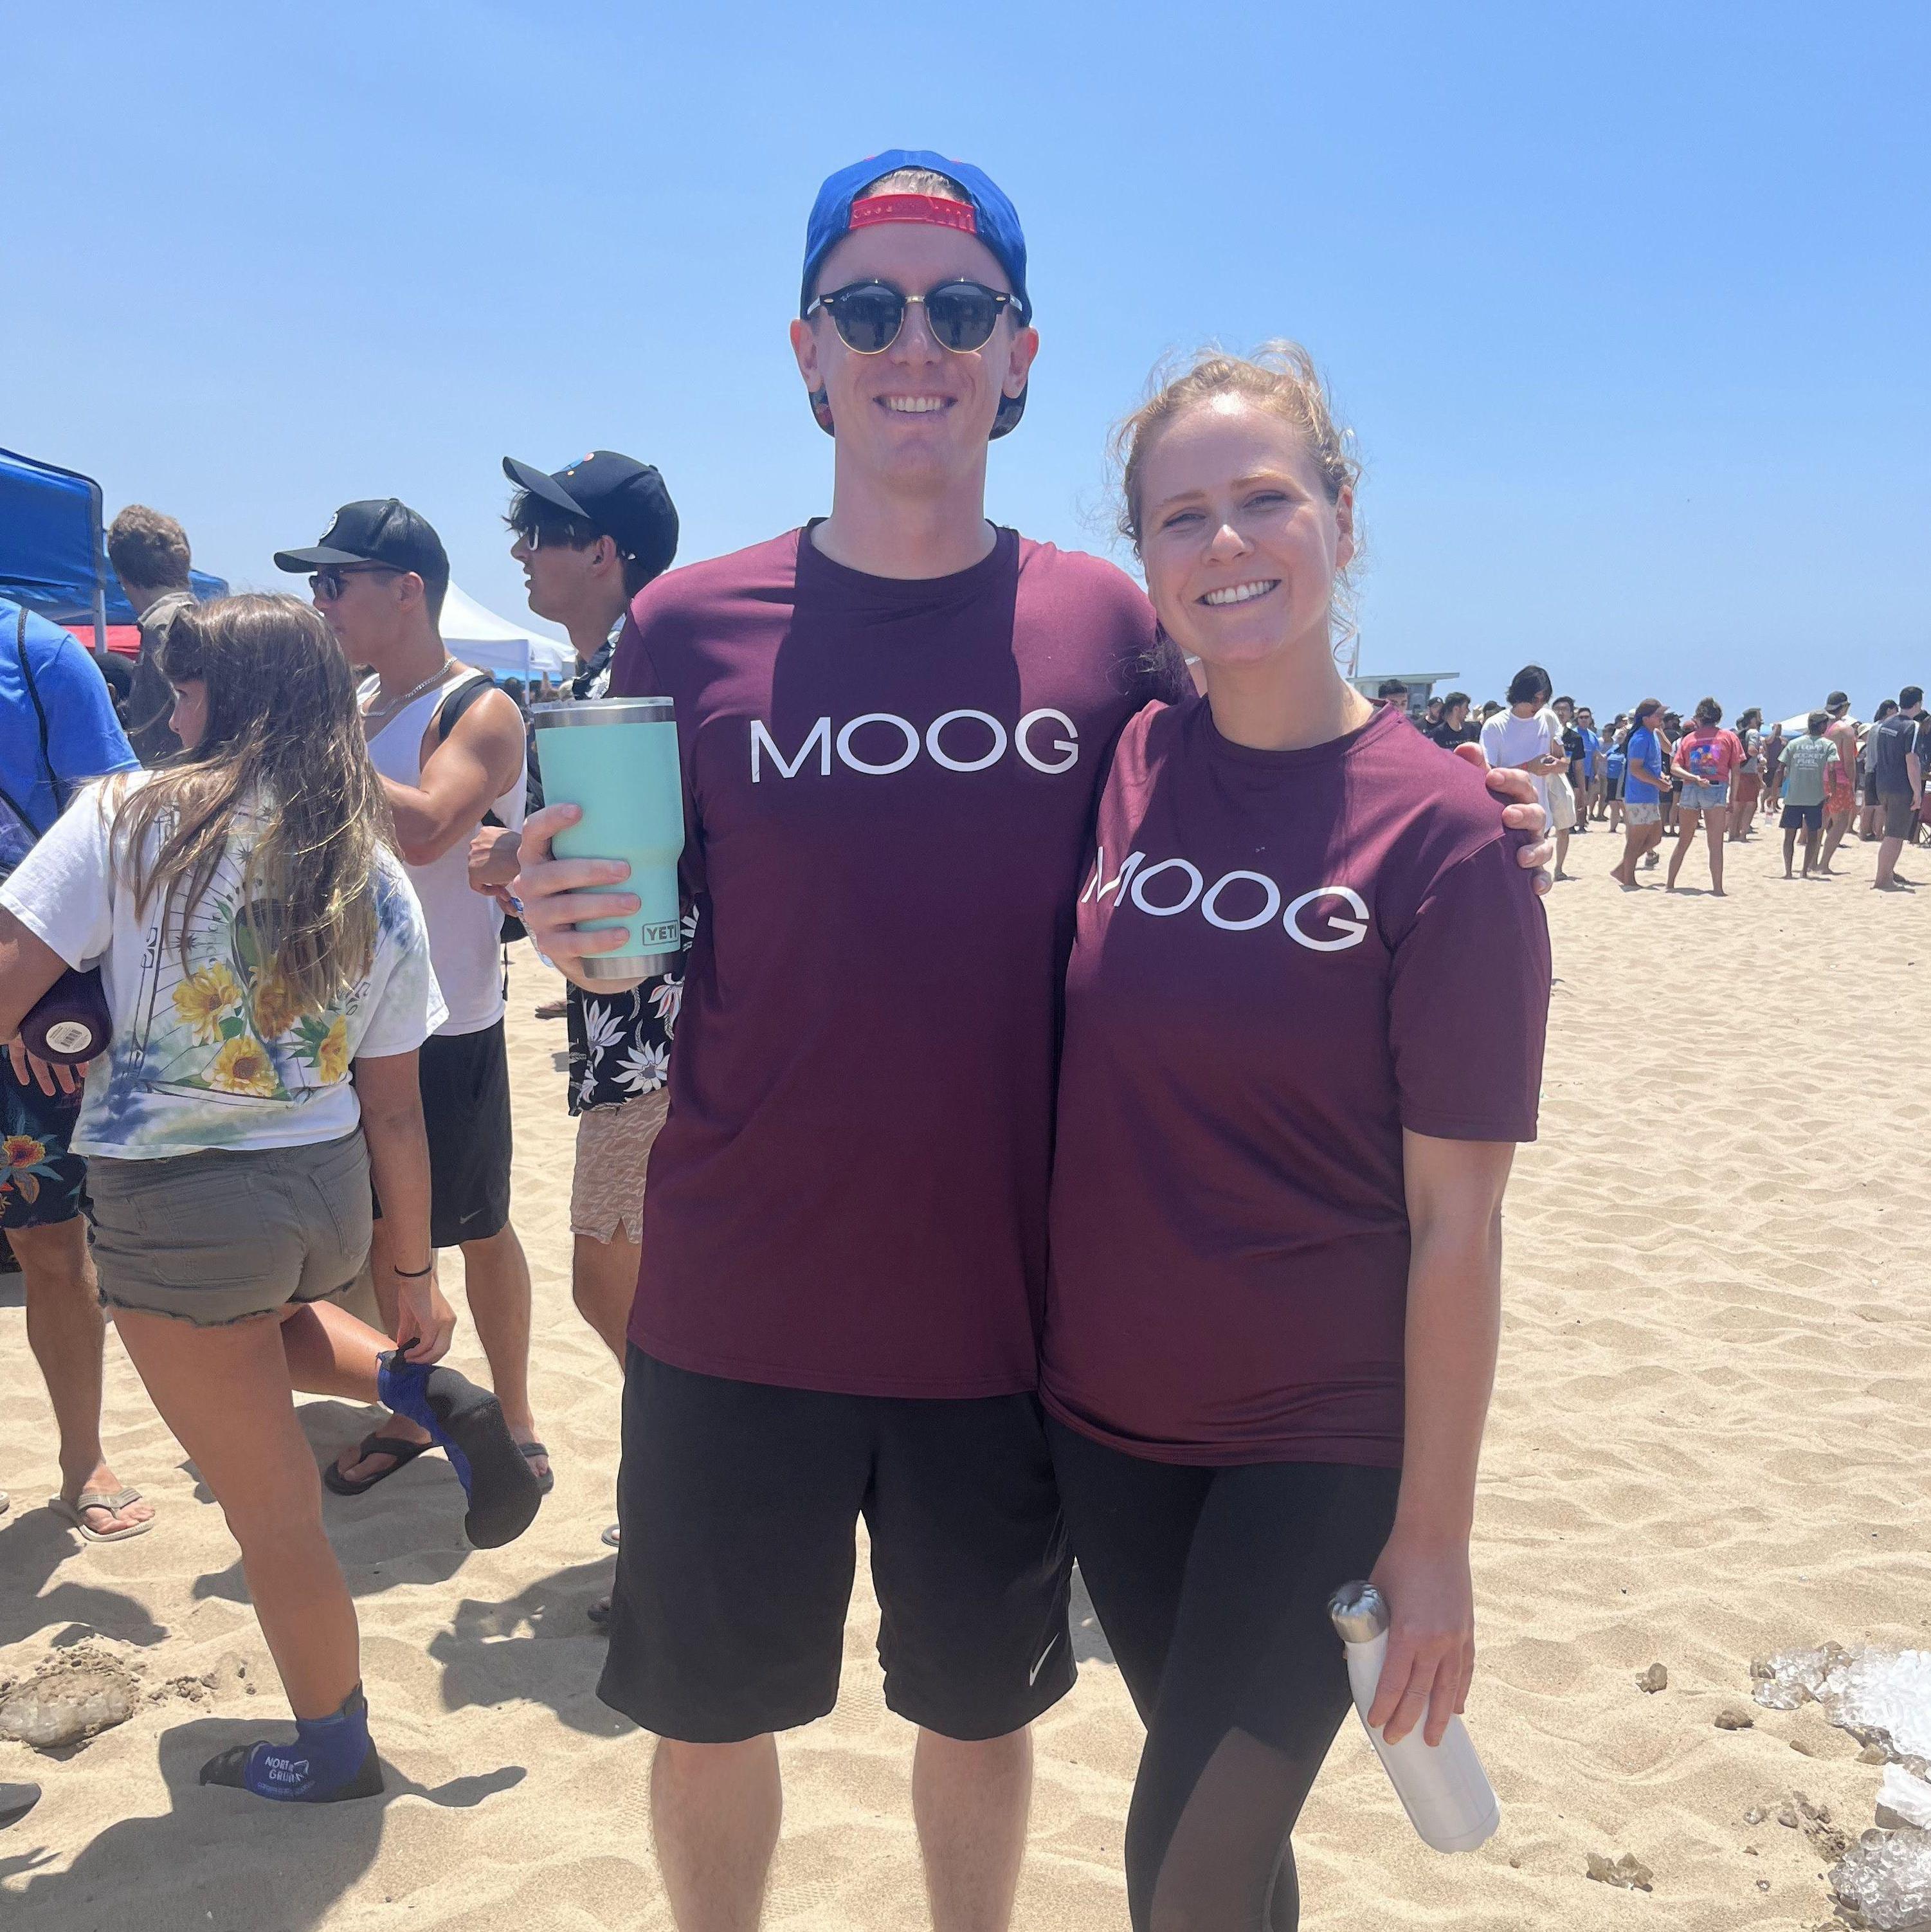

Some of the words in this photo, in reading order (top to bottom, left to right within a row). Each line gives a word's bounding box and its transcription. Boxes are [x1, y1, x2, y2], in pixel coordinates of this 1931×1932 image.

[750, 708, 1078, 783] MOOG
[646, 925, 676, 940] YETI
[1081, 846, 1370, 952] MOOG
